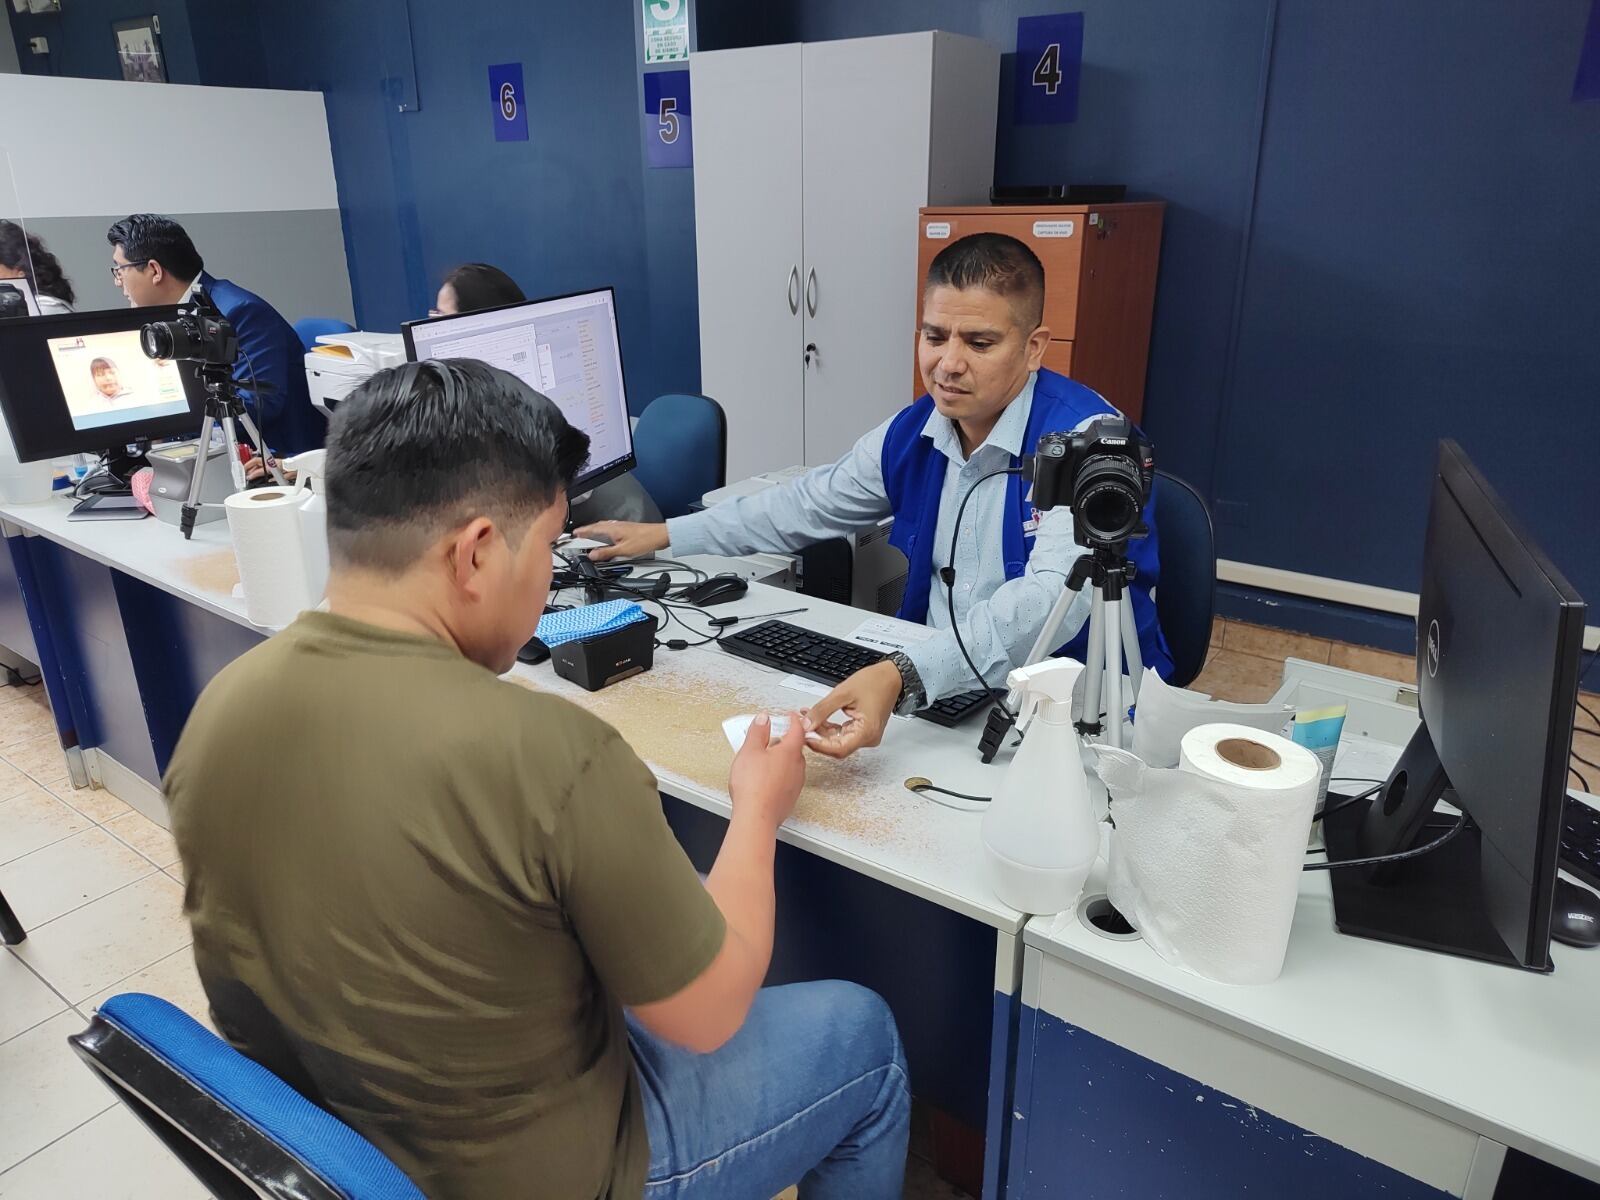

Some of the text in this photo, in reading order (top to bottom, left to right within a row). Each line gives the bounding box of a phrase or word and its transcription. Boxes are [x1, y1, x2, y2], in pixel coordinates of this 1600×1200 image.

[1032, 43, 1062, 95] 4
[500, 82, 517, 121] 6
[659, 97, 680, 144] 5
